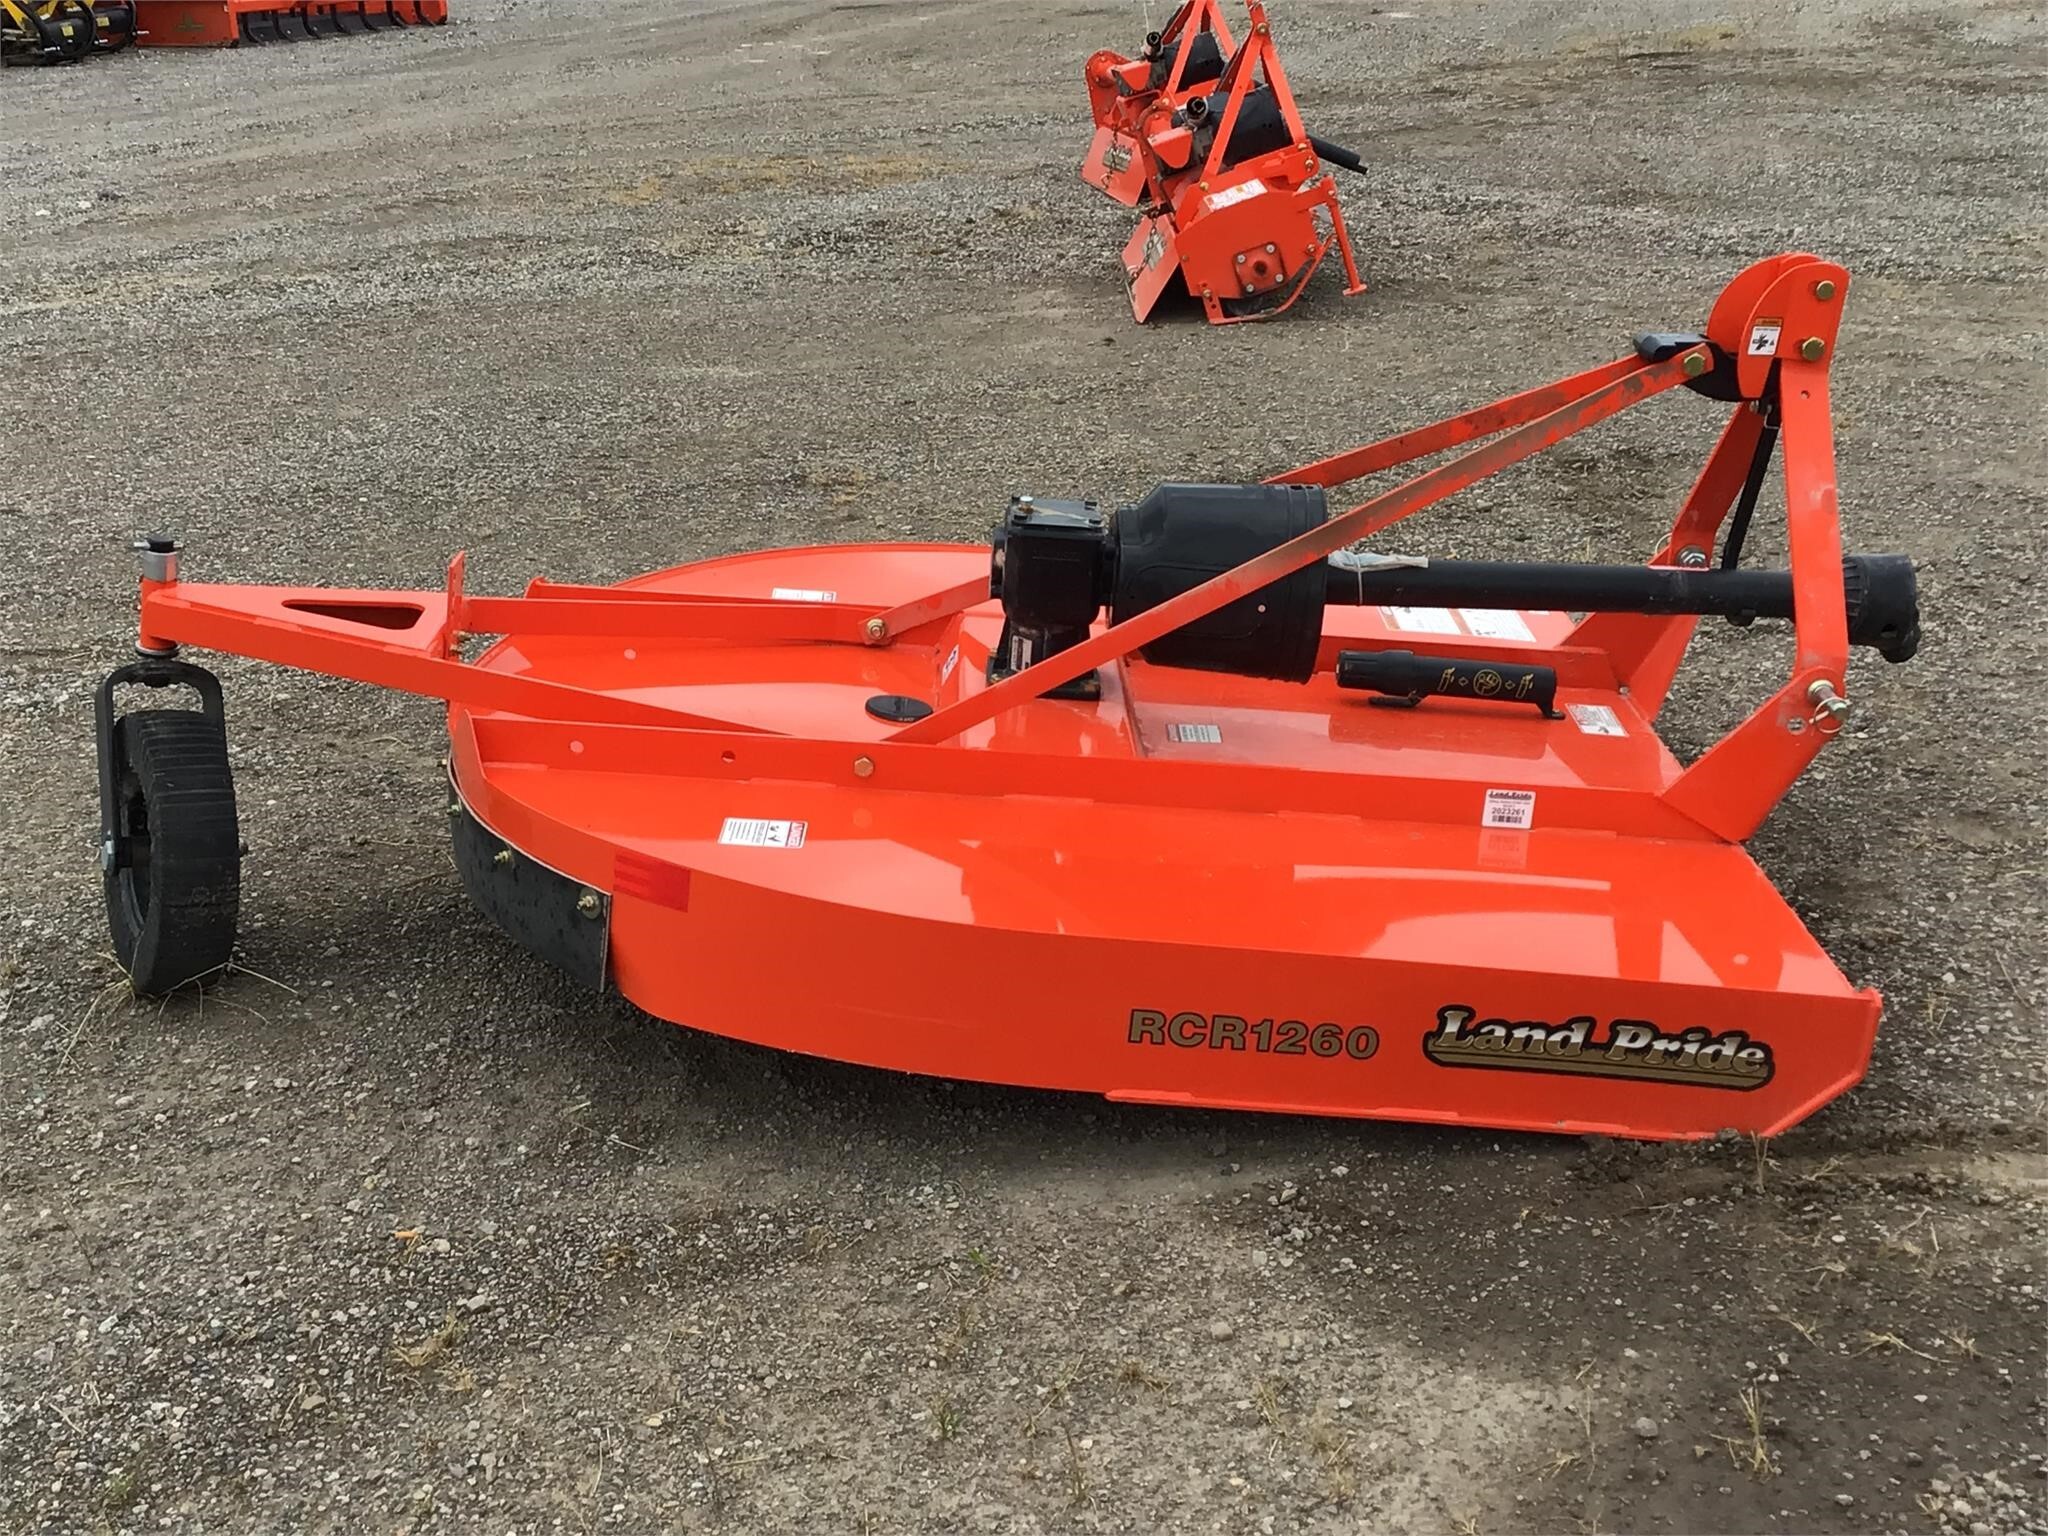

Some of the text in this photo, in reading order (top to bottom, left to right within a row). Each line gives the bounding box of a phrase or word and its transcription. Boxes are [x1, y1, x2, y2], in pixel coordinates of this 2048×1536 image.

[1492, 807, 1526, 815] 2023261
[1128, 1008, 1380, 1060] RCR1260
[1432, 1009, 1767, 1074] Land Pride
